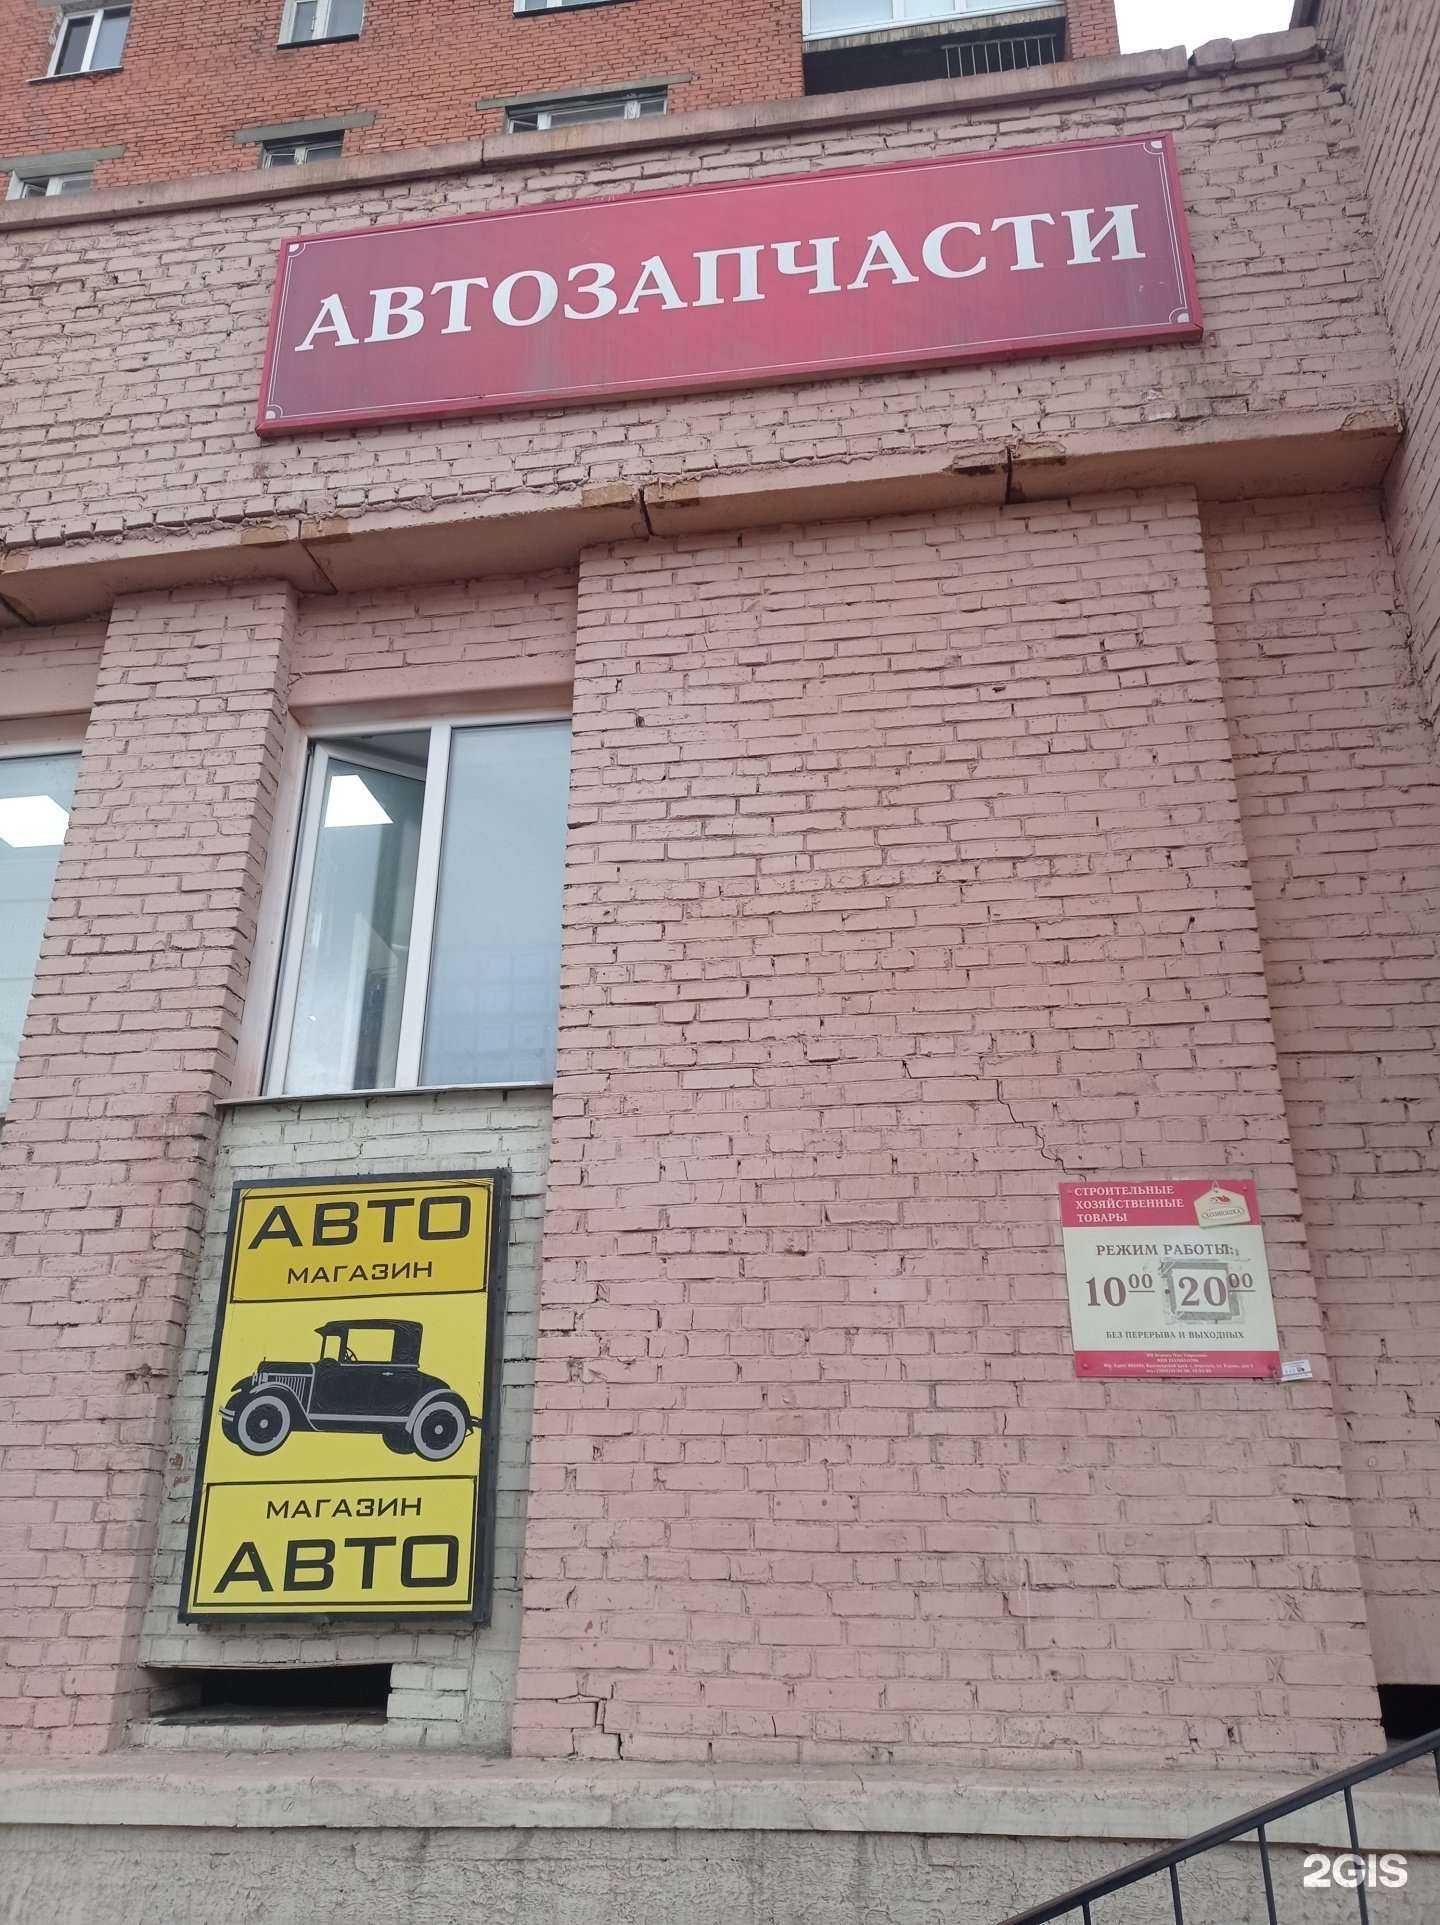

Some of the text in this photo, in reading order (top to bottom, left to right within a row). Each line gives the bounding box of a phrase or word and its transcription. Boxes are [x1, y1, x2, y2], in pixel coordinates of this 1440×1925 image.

[293, 203, 1147, 352] АВТОЗАПЧАСТИ
[1074, 1185, 1175, 1196] СТРОИТЕЛЬНЫЕ
[1075, 1197, 1185, 1210] ХОЗЯЙСТВЕННЫЕ
[247, 1195, 472, 1250] АВТО
[1077, 1212, 1128, 1223] ТОВАРЫ
[1096, 1244, 1159, 1256] РЕЖИМ
[287, 1260, 433, 1285] МАГАЗИН
[1105, 1330, 1245, 1340] БЕЗ ПЕРЕРЫВА И ВЫХОДНЫХ
[266, 1497, 422, 1519] МАГАЗИН
[213, 1534, 460, 1594] АВТО
